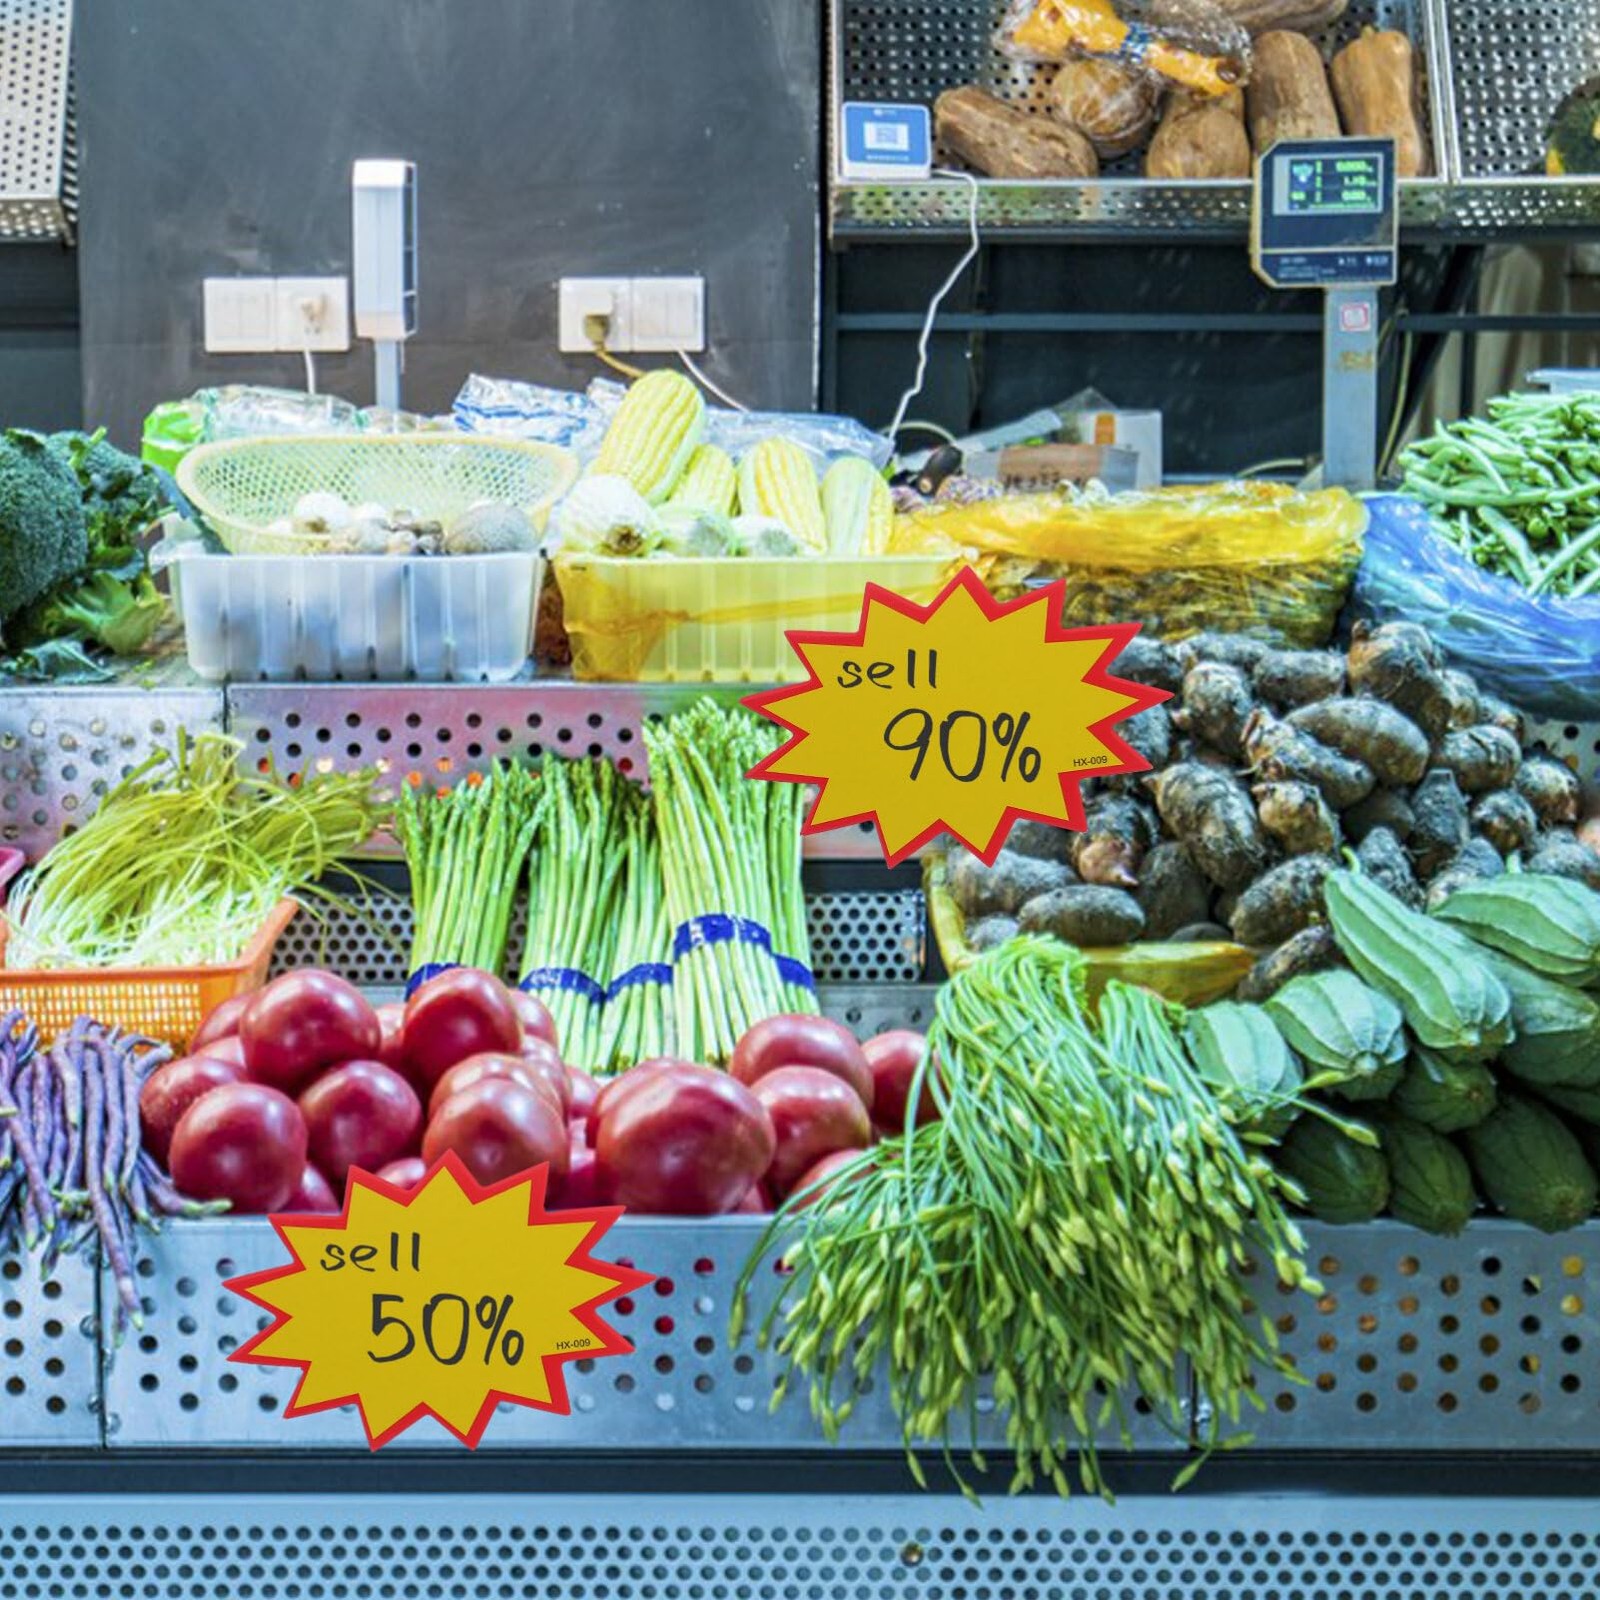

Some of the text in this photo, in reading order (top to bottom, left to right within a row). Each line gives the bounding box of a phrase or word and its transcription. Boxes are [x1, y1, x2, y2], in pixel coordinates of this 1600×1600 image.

[837, 648, 938, 689] sell
[883, 708, 1042, 783] 90%
[1073, 755, 1108, 767] HX-009
[320, 1231, 420, 1272] sell
[367, 1293, 525, 1366] 50%
[555, 1338, 591, 1350] HX-009
